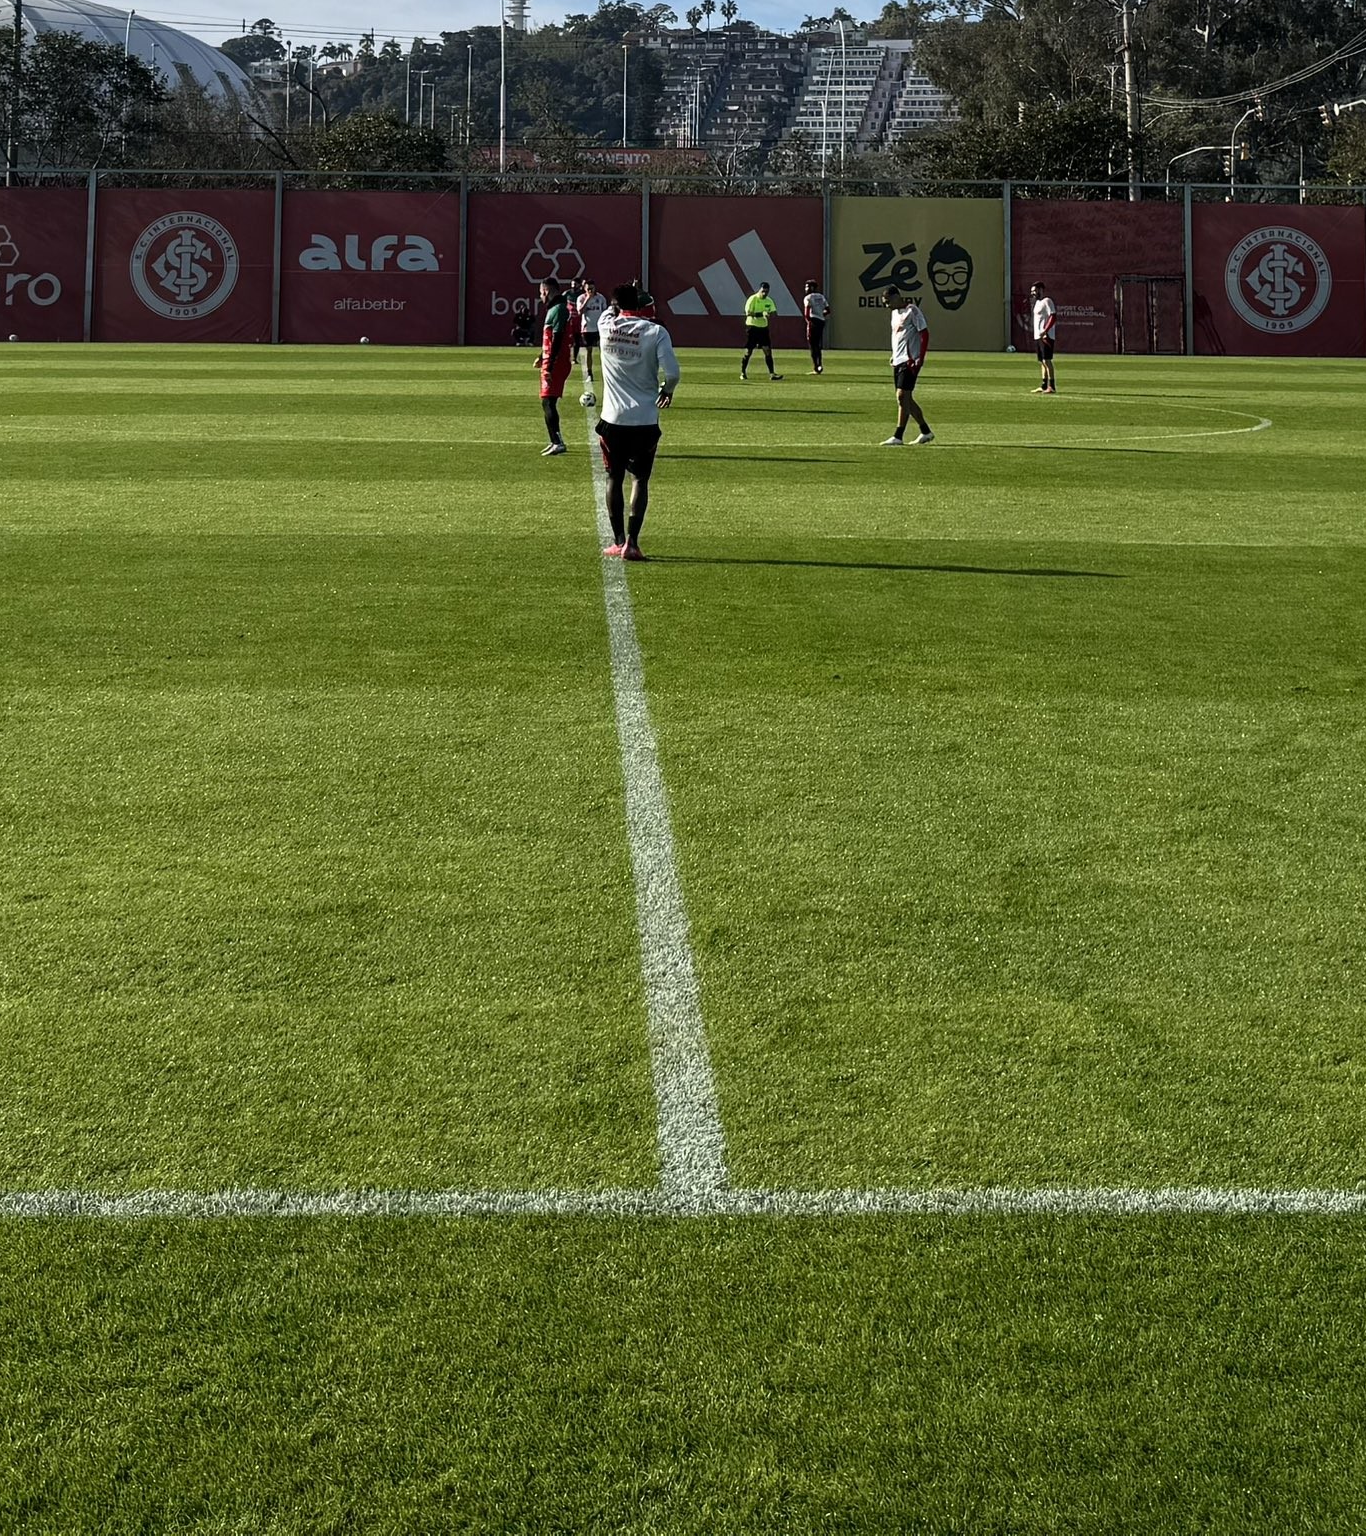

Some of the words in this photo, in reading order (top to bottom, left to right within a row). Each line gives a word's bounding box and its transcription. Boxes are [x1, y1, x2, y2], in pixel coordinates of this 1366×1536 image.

[299, 234, 440, 272] alfa
[859, 243, 923, 292] Zé
[334, 298, 407, 311] alfa.bet.br
[169, 307, 198, 316] 1909
[1265, 321, 1294, 330] 1909
